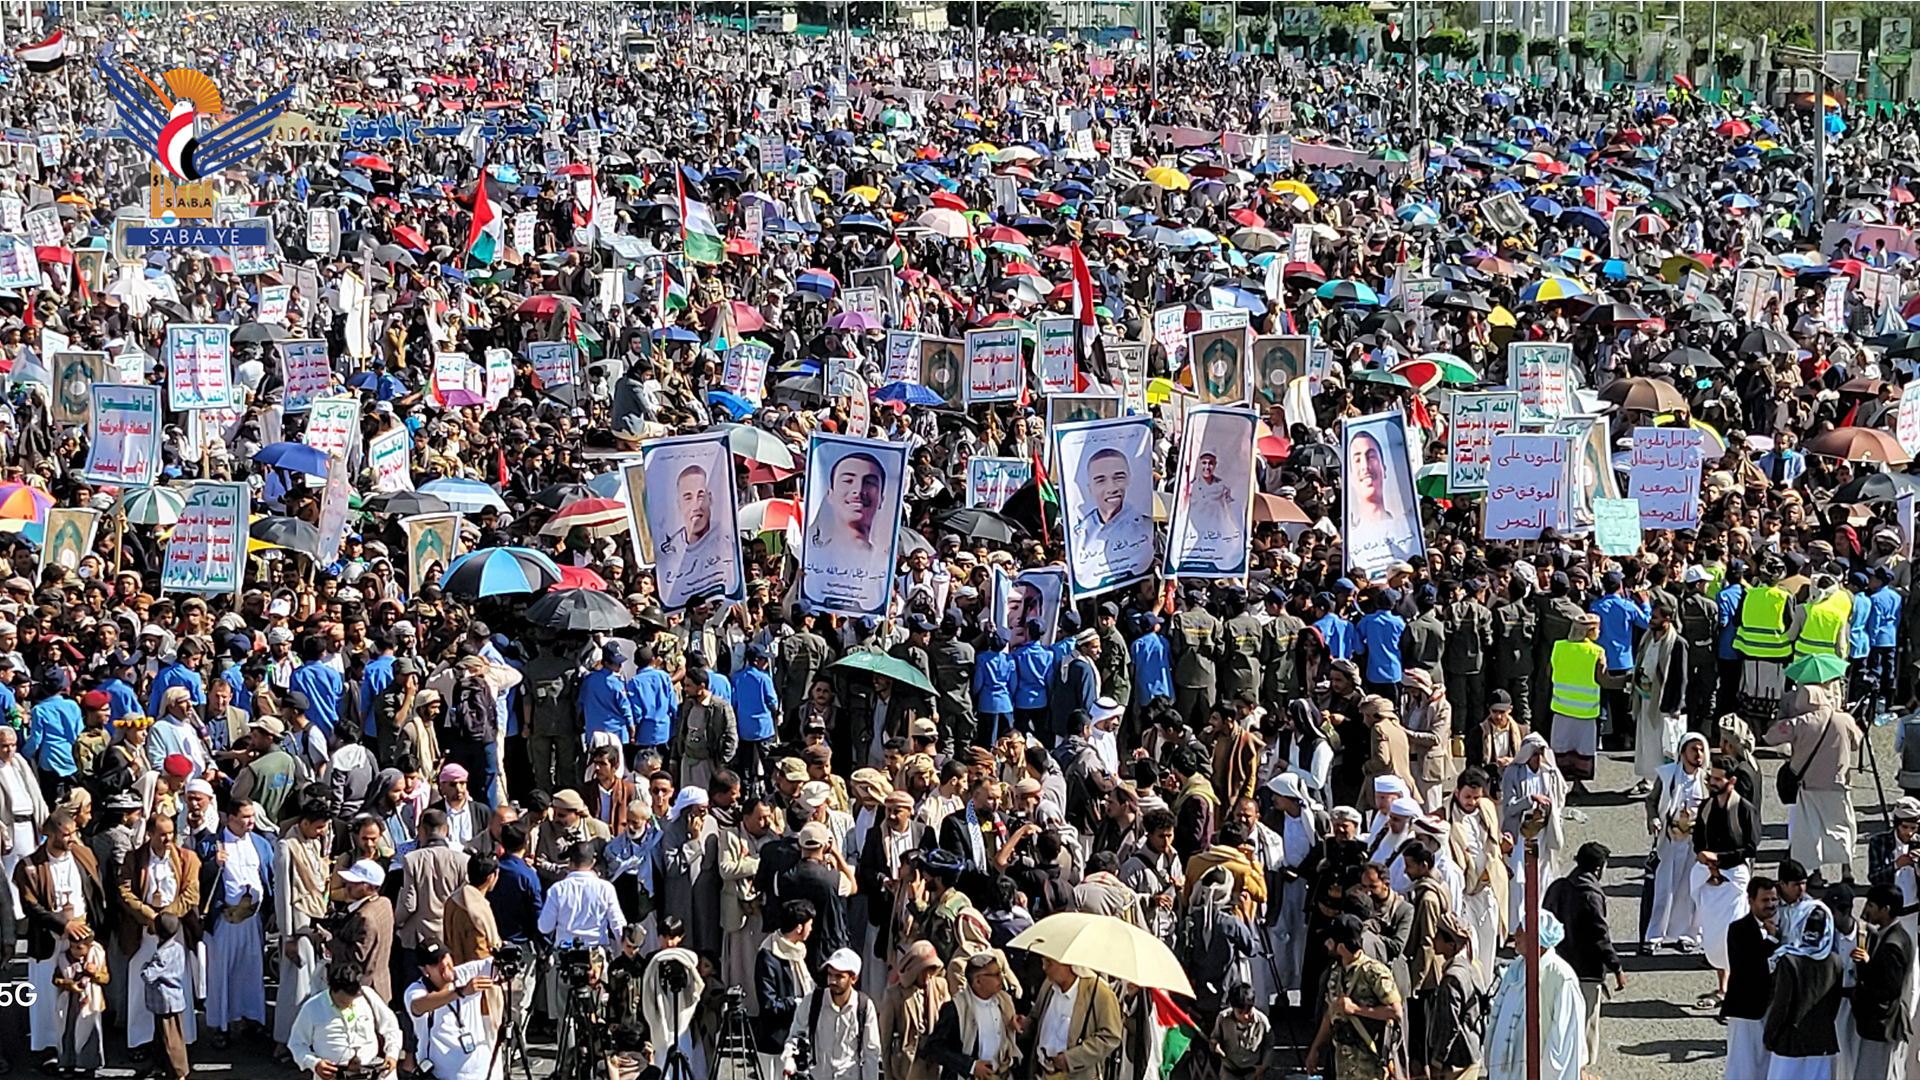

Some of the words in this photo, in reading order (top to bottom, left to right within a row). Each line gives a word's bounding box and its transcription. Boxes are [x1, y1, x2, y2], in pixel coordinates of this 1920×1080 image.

[1493, 398, 1514, 413] الله
[1497, 439, 1522, 467] على
[211, 490, 236, 508] الله
[1496, 507, 1547, 531] النصر
